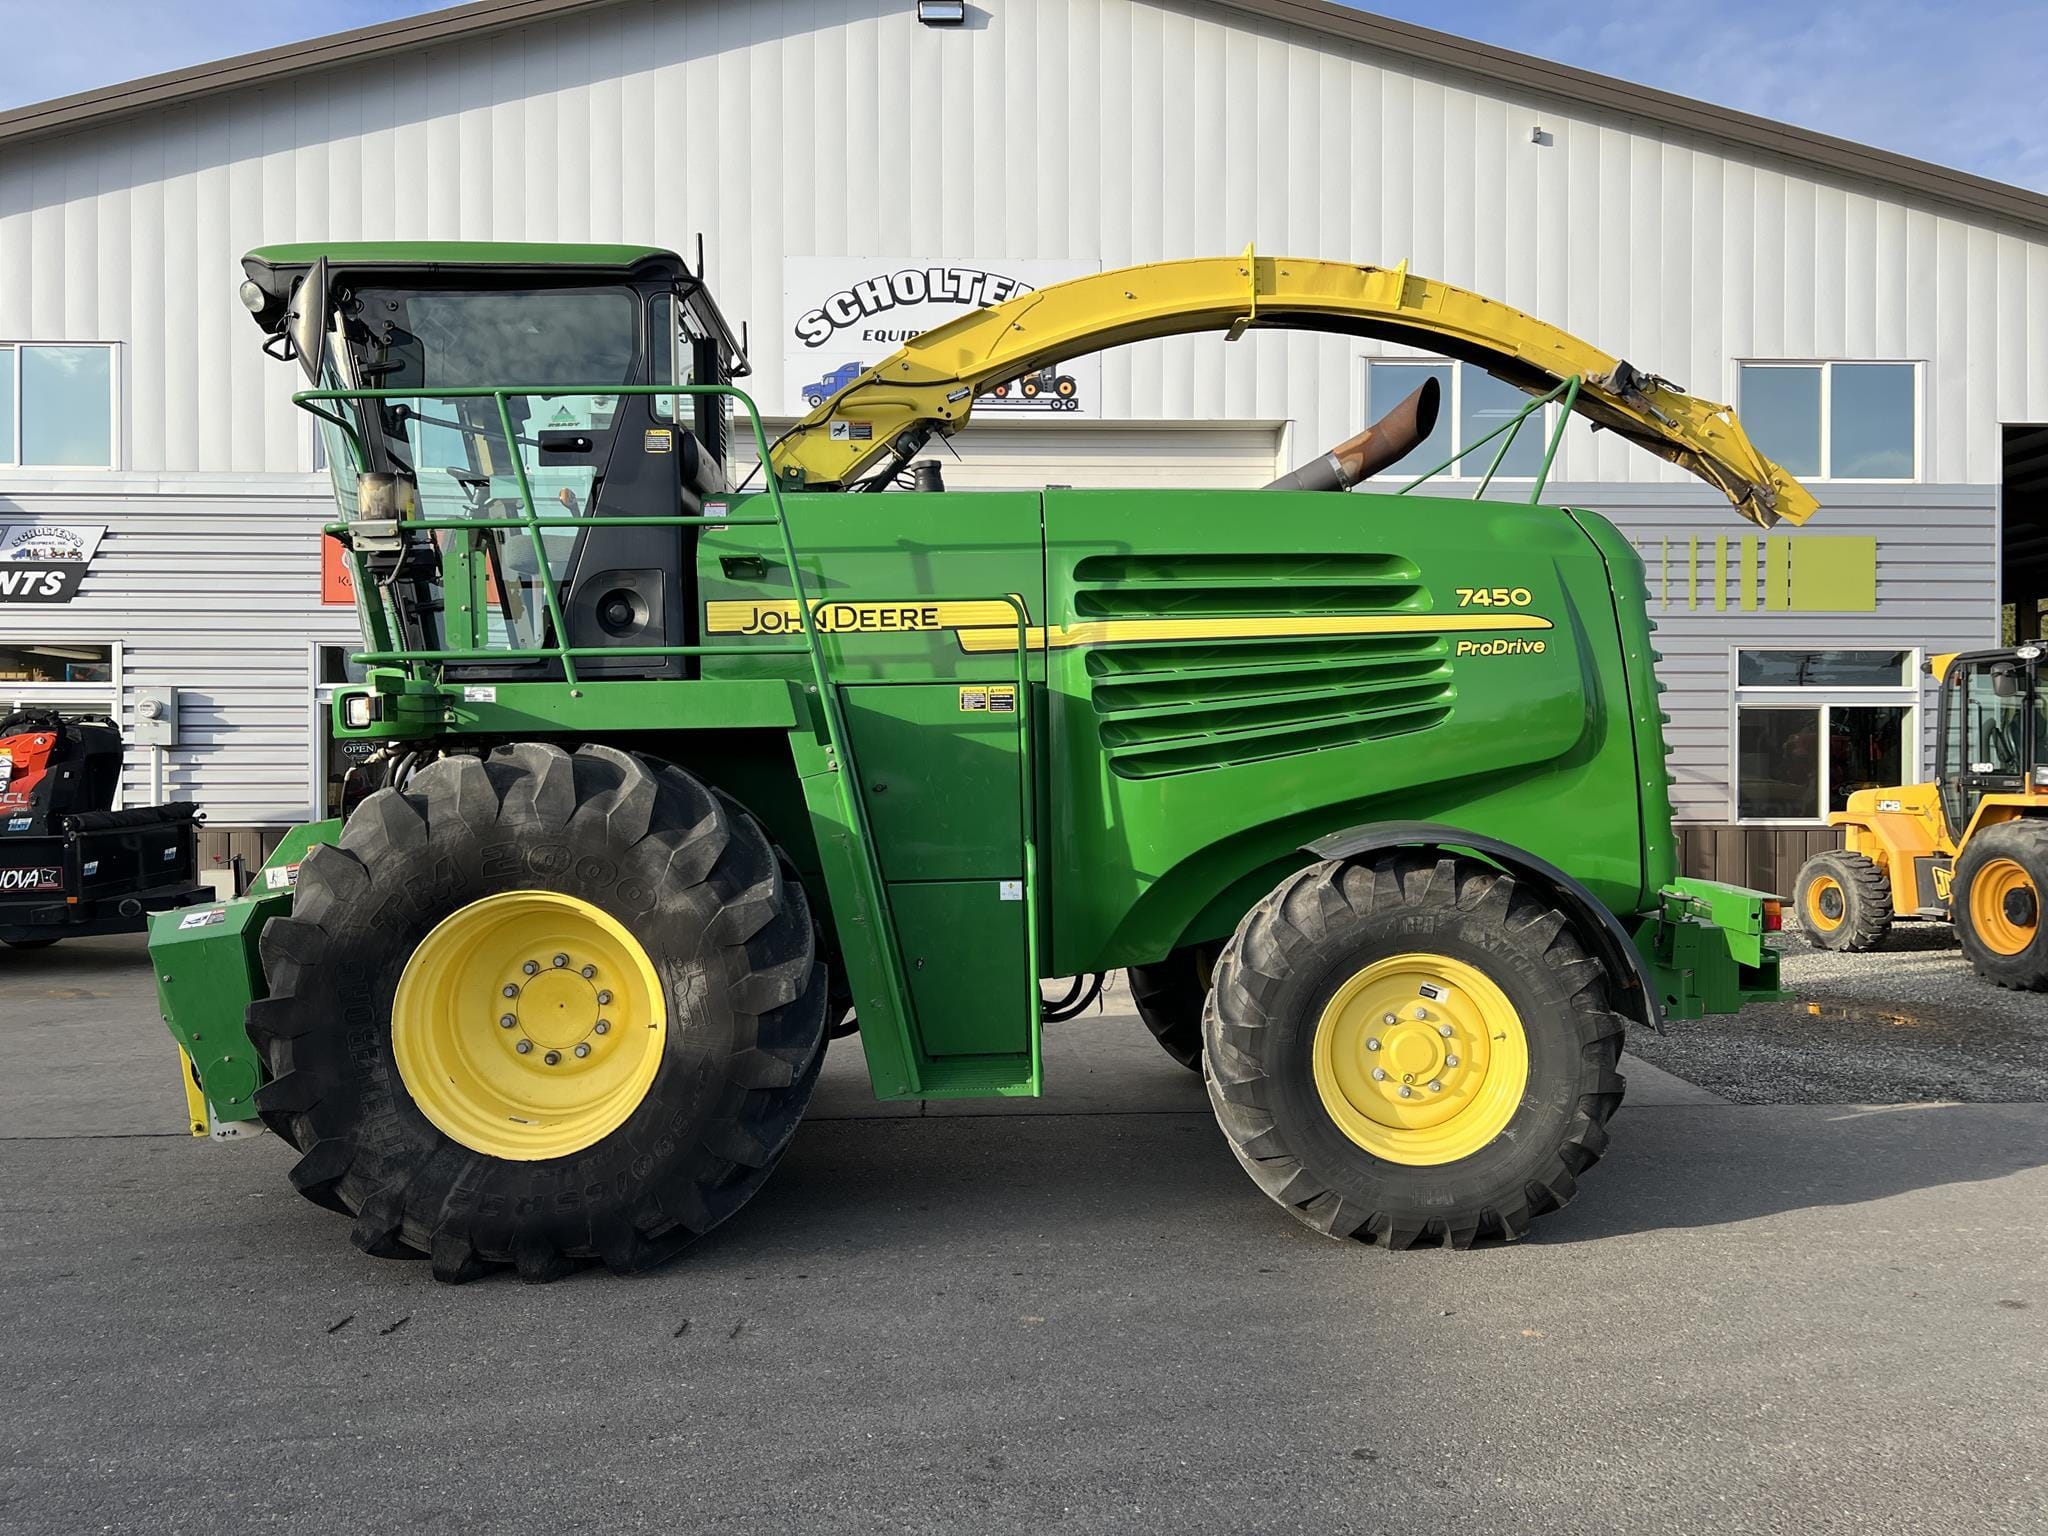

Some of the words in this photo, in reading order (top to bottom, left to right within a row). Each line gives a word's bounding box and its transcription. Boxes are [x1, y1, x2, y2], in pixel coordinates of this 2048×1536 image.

[862, 329, 927, 344] EQUIP
[12, 527, 84, 547] SCHOLTEN'S
[1456, 588, 1532, 607] 7450
[742, 607, 827, 631] JOHN
[835, 606, 938, 629] DEERE
[1456, 638, 1546, 657] ProDrive
[343, 745, 374, 754] OPEN
[1876, 800, 1901, 812] JCB
